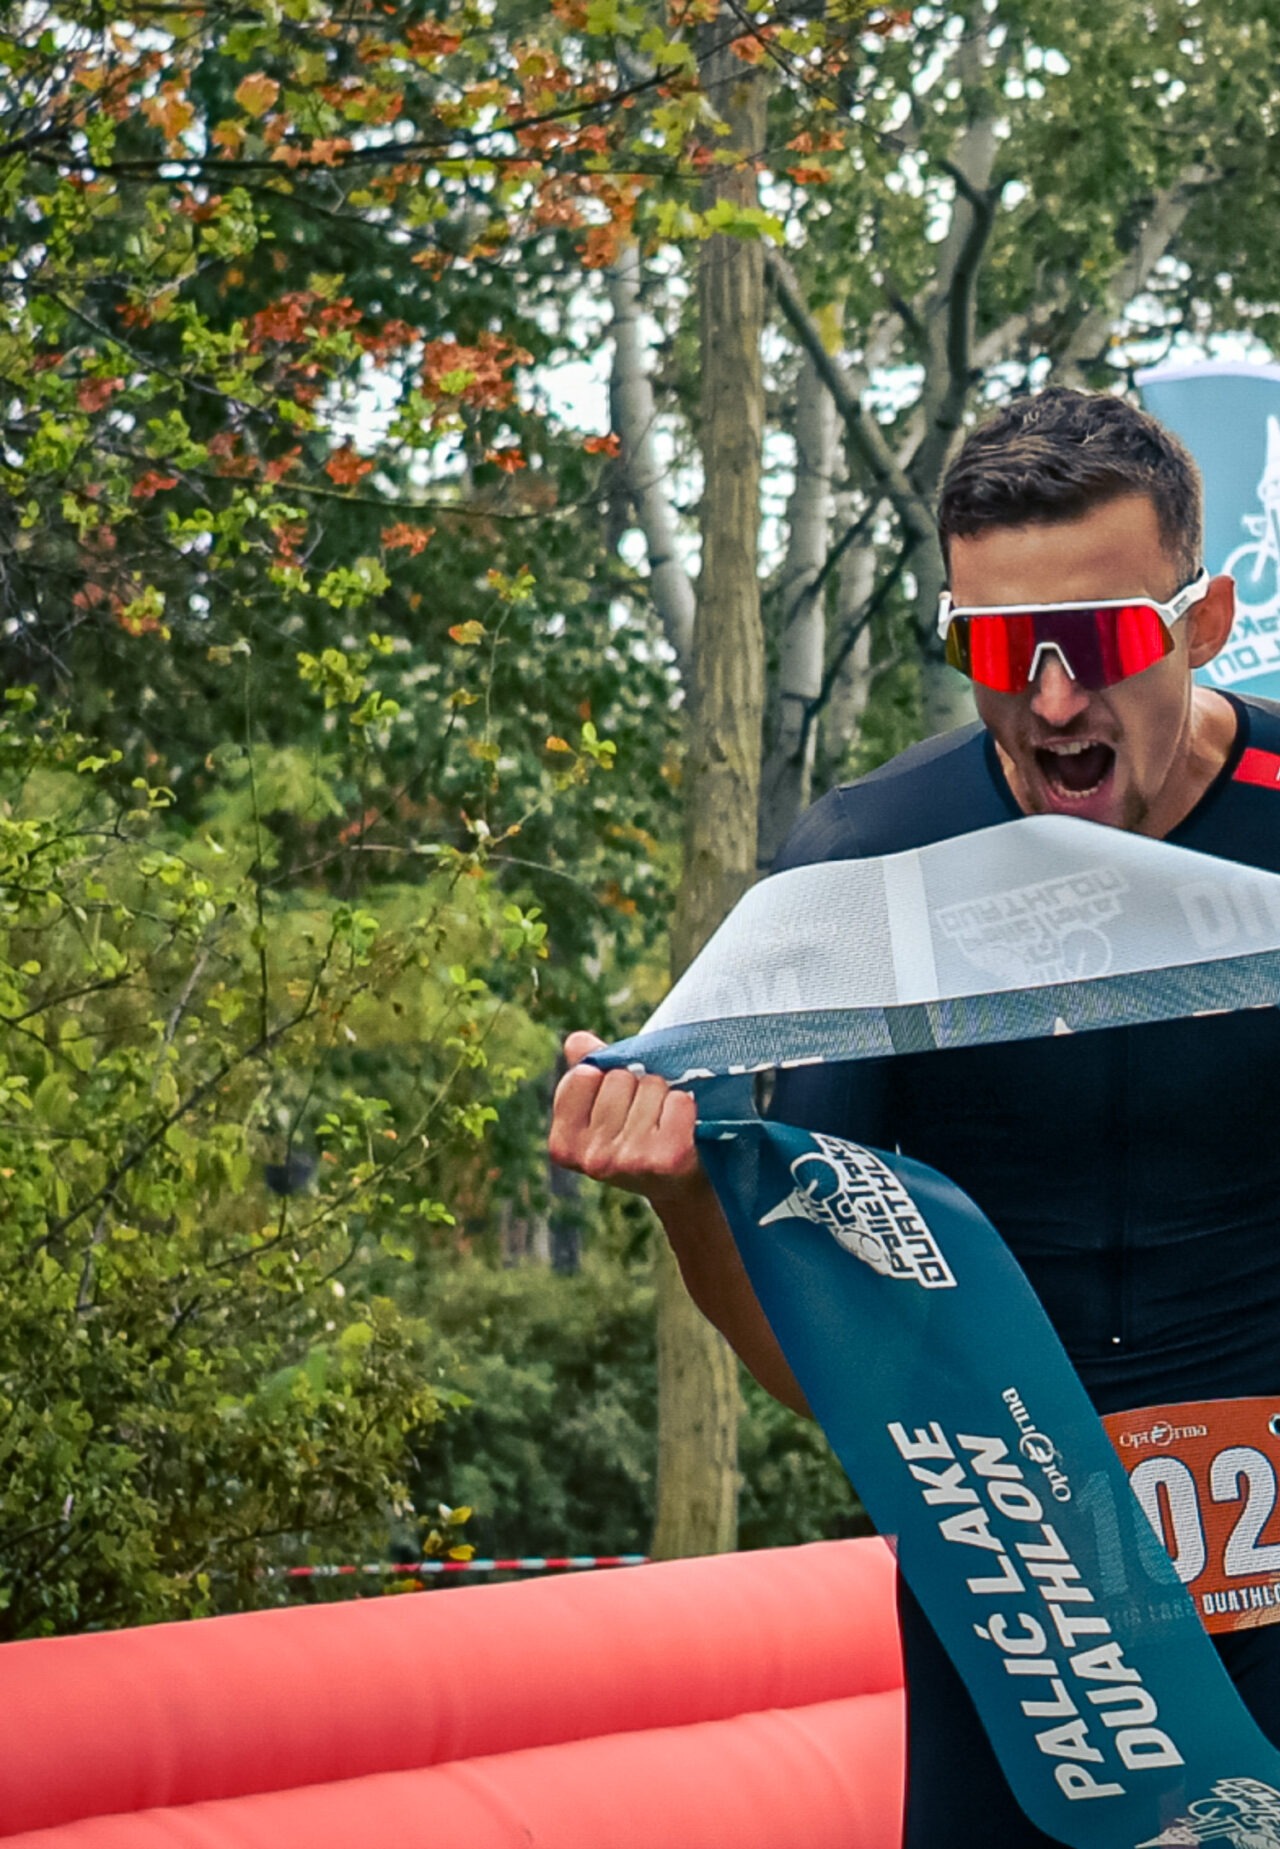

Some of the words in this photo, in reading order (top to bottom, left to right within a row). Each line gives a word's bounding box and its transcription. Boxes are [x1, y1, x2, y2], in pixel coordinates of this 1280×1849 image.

[836, 1138, 949, 1282] DUATHL
[887, 1420, 1026, 1595] LAKE
[956, 1433, 1186, 1771] DUATHLON
[972, 1612, 1126, 1801] PALIĆ
